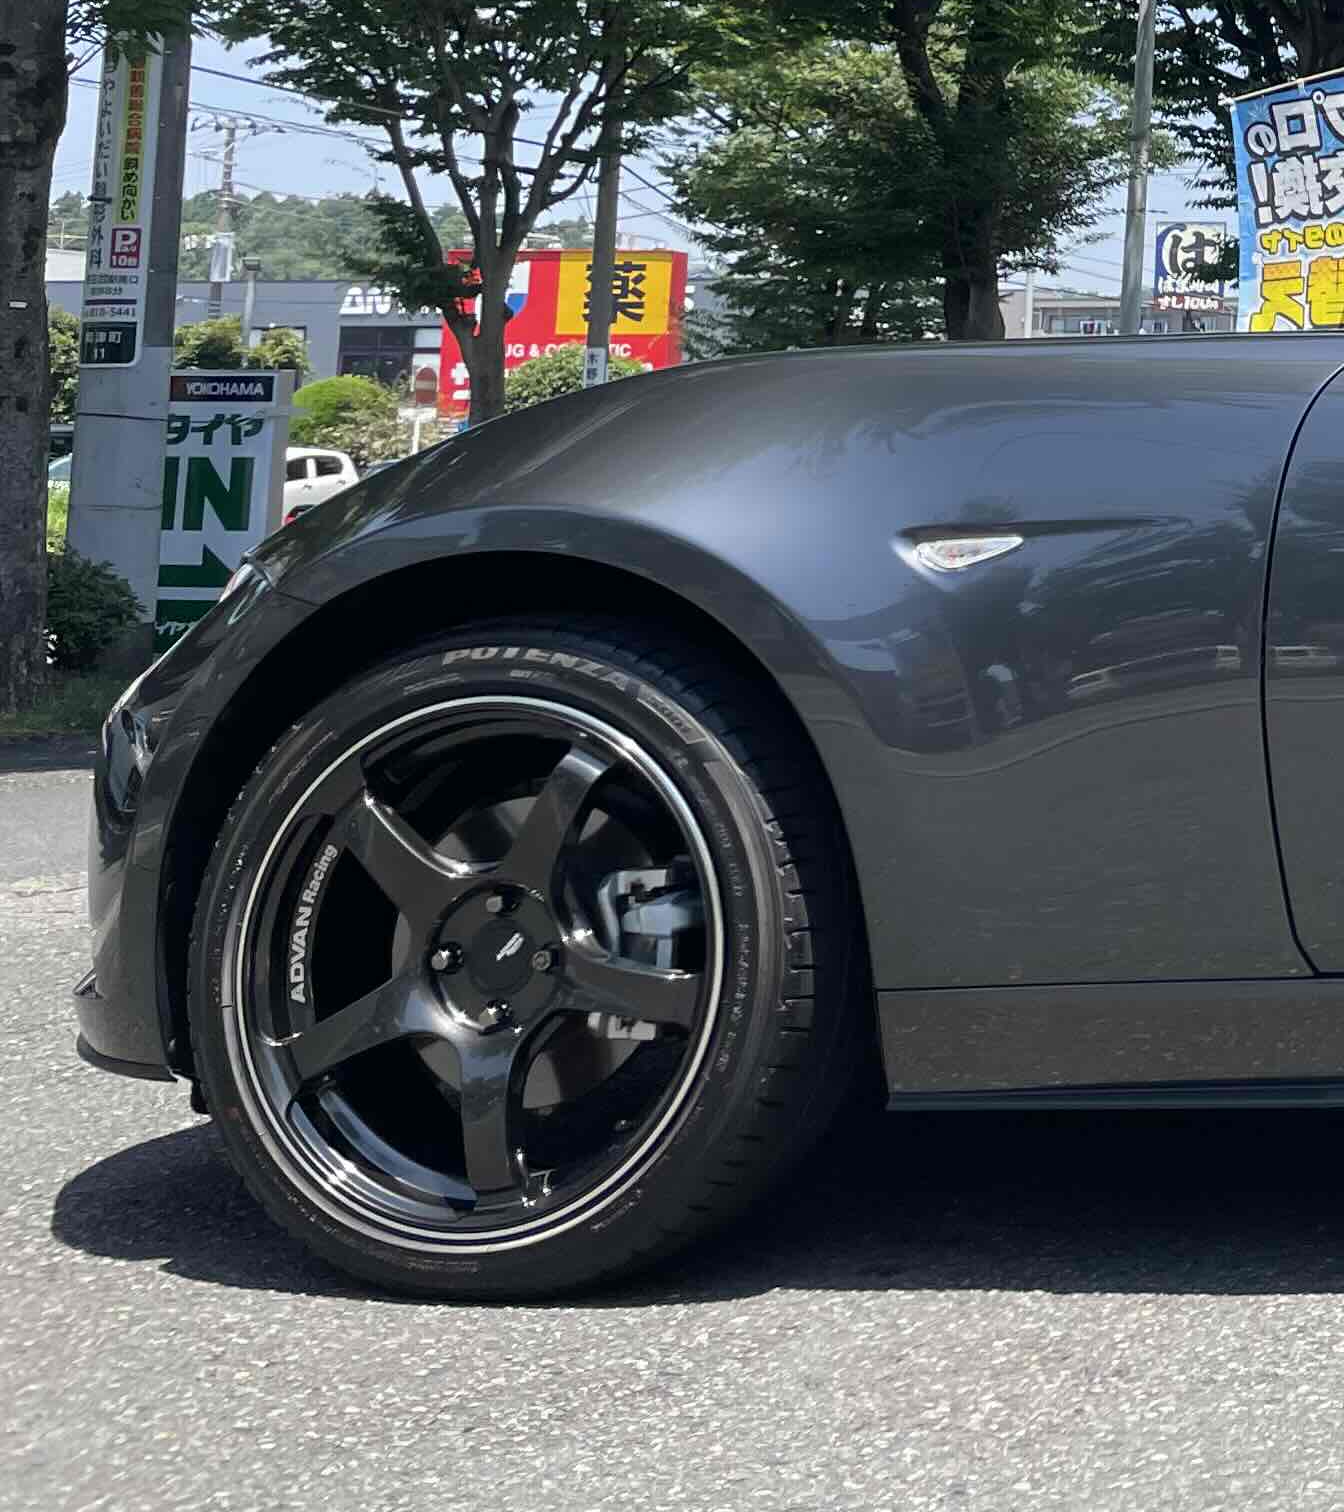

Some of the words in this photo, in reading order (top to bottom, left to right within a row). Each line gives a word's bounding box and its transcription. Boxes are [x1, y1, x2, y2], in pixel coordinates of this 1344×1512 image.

[583, 261, 646, 324] 薬
[186, 382, 264, 396] YOKOHAMA
[166, 413, 264, 445] タイヤ
[161, 457, 254, 531] IN
[442, 647, 627, 691] POTENZA
[290, 906, 312, 1004] ADVAN
[302, 844, 338, 904] Racing
